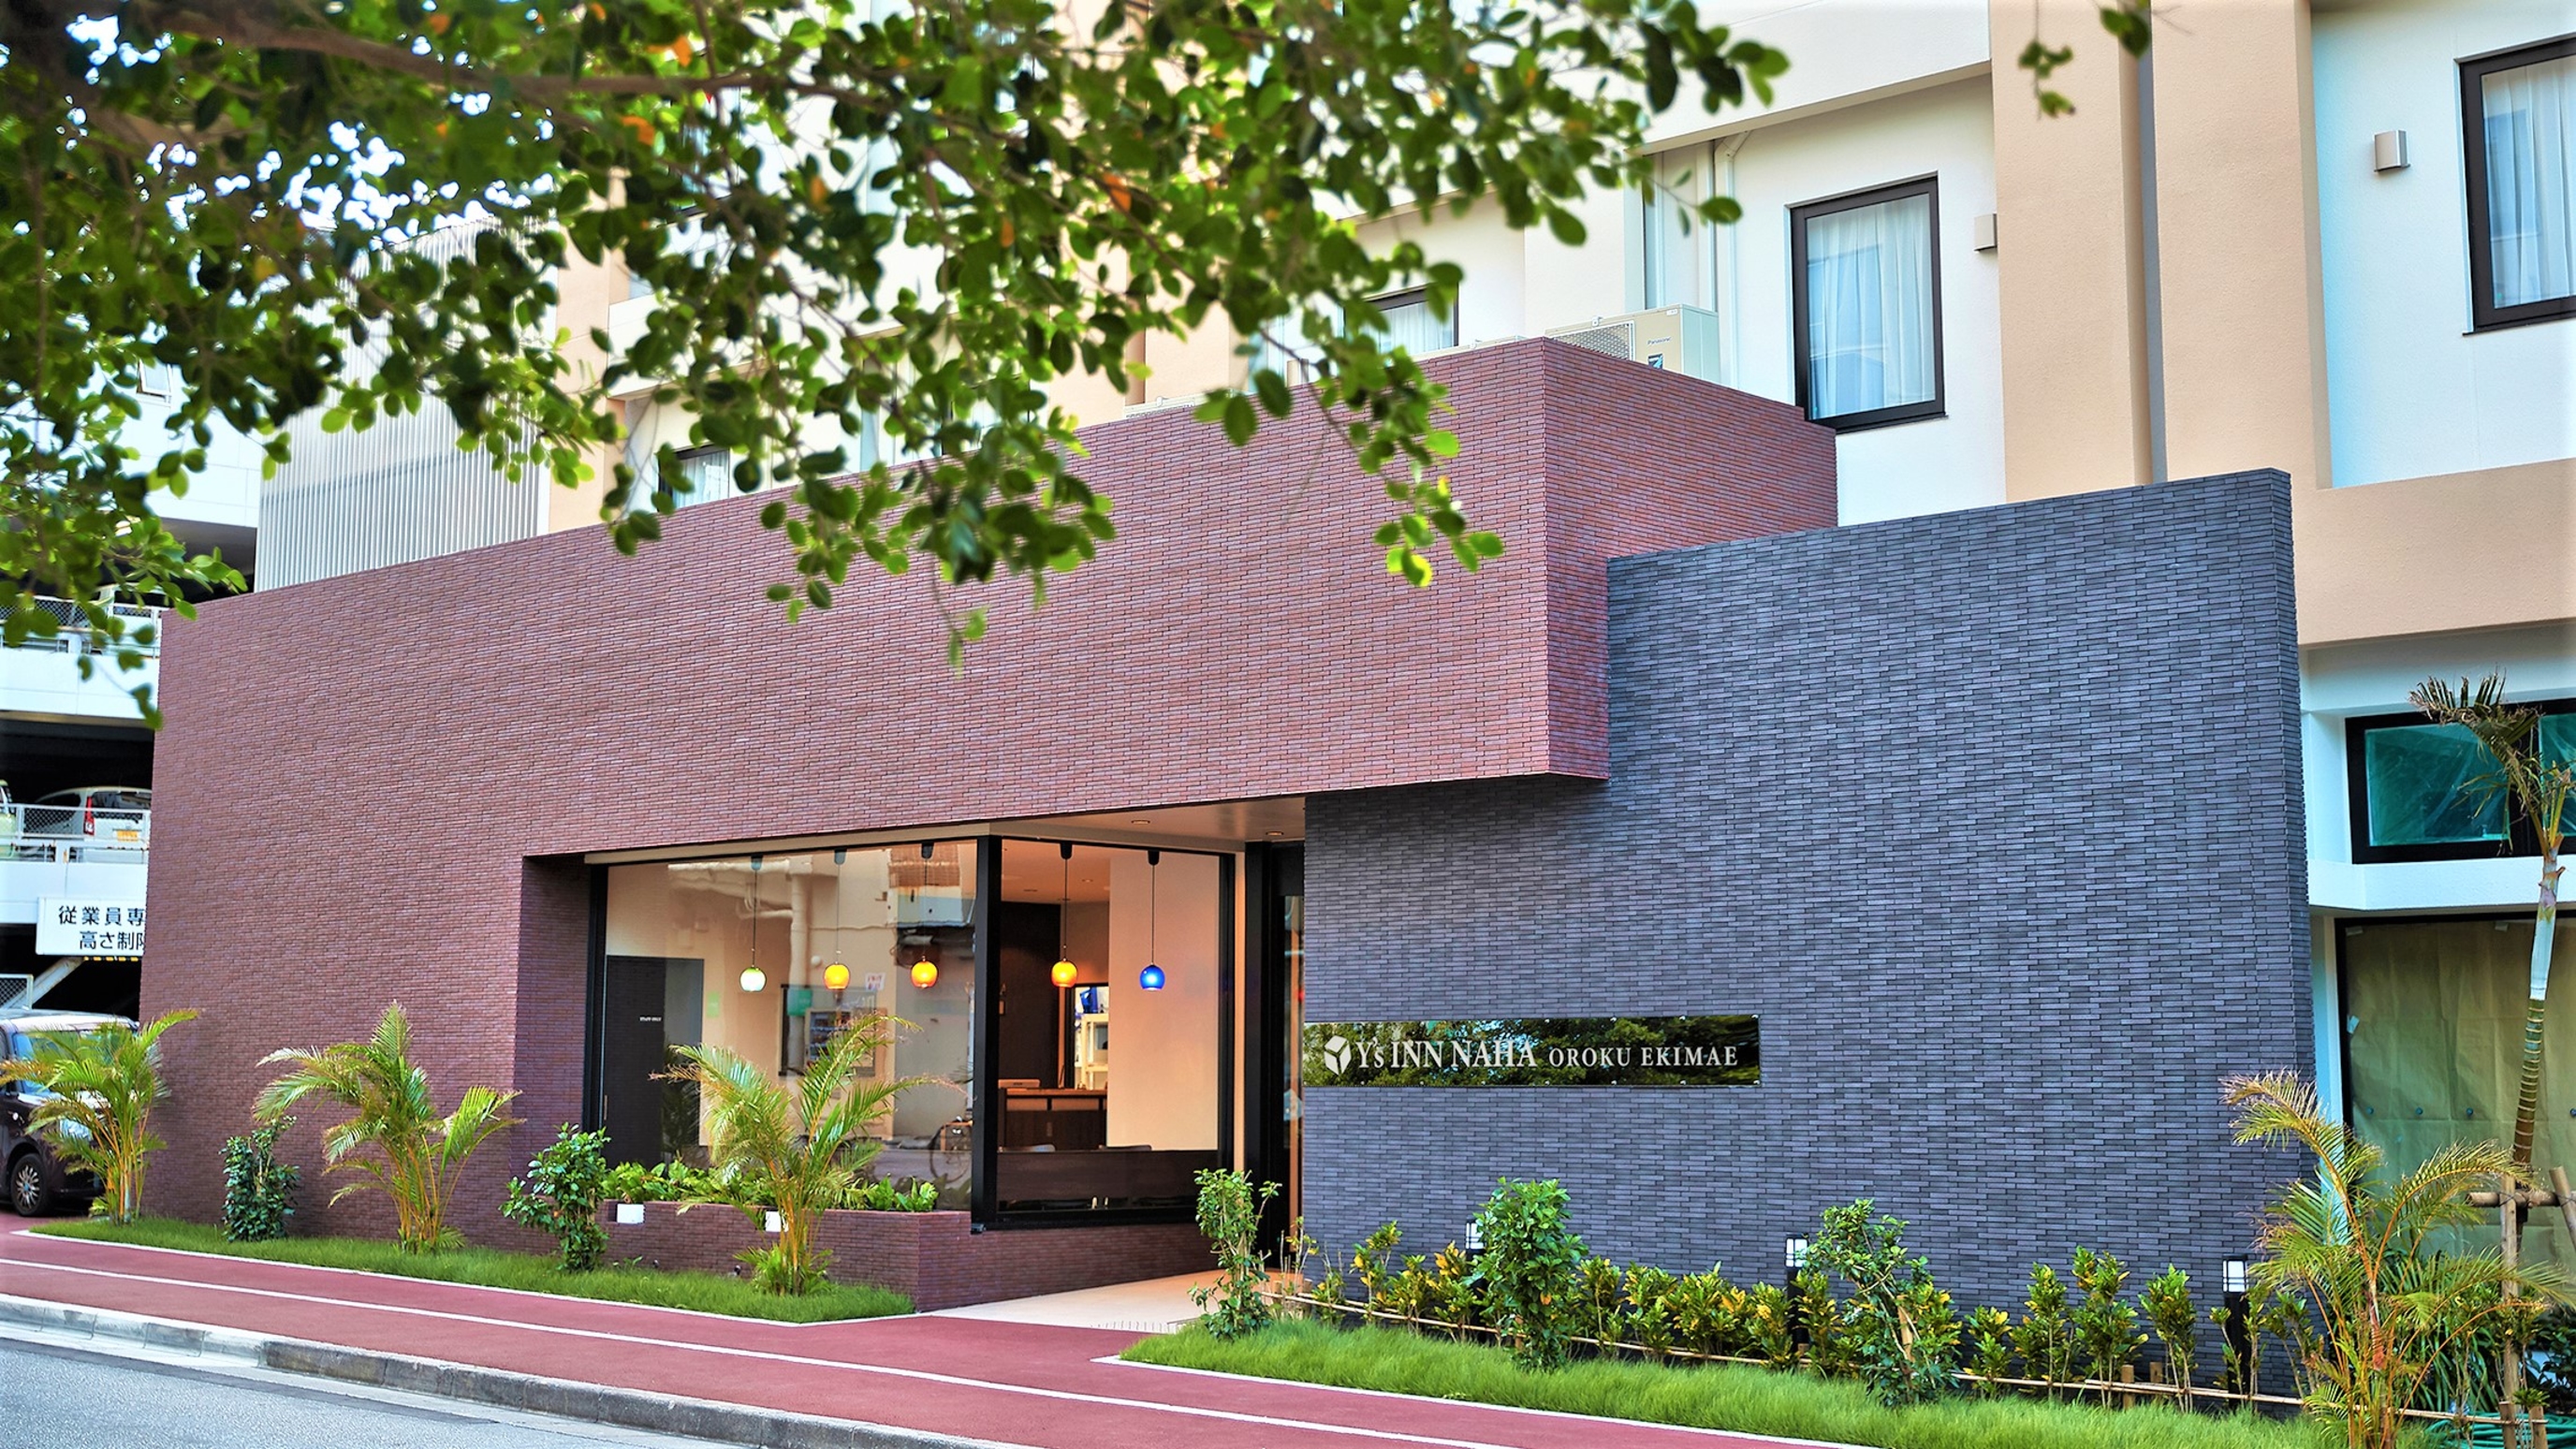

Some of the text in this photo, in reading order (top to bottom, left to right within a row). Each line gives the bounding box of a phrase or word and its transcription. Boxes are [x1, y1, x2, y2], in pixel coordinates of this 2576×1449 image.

[1390, 1040, 1443, 1068] INN
[1451, 1040, 1538, 1068] NAHA
[1548, 1047, 1631, 1067] OROKU
[1641, 1046, 1739, 1066] EKIMAE
